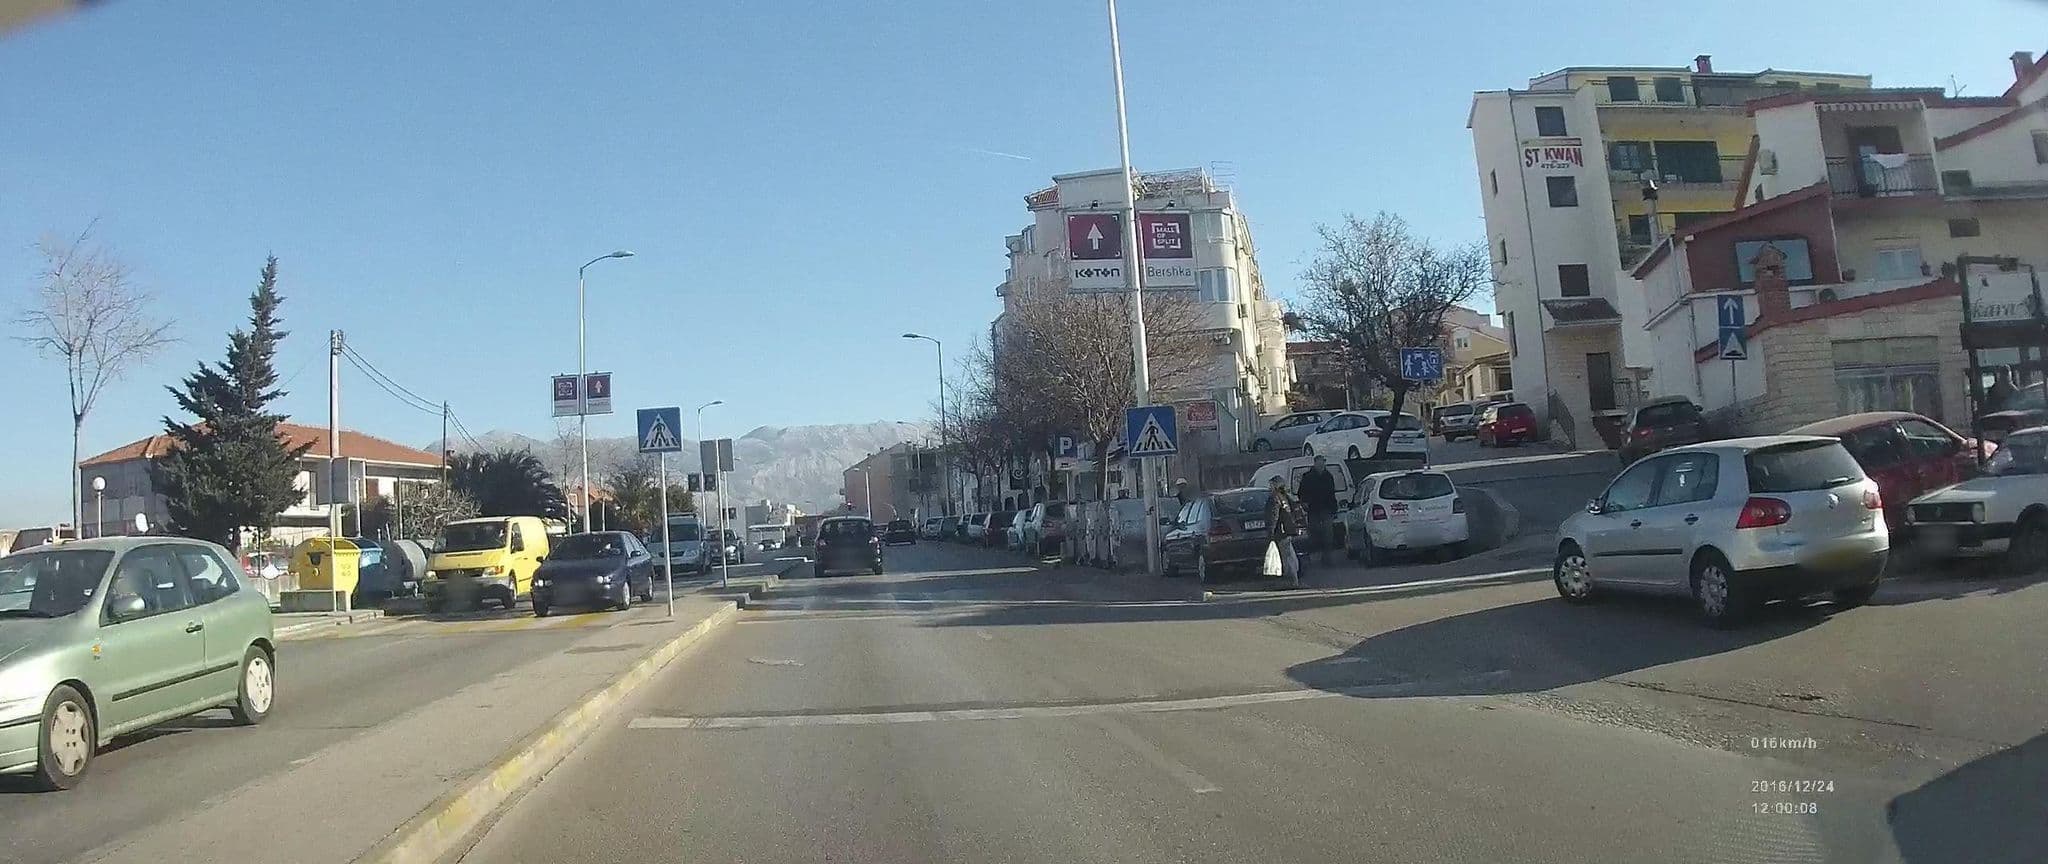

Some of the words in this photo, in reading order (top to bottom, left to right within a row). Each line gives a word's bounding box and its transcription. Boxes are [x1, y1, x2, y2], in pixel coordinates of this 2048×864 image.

[1525, 149, 1540, 168] ST
[1545, 148, 1584, 167] KWAN
[1148, 266, 1192, 278] Bershka
[1060, 437, 1073, 455] P
